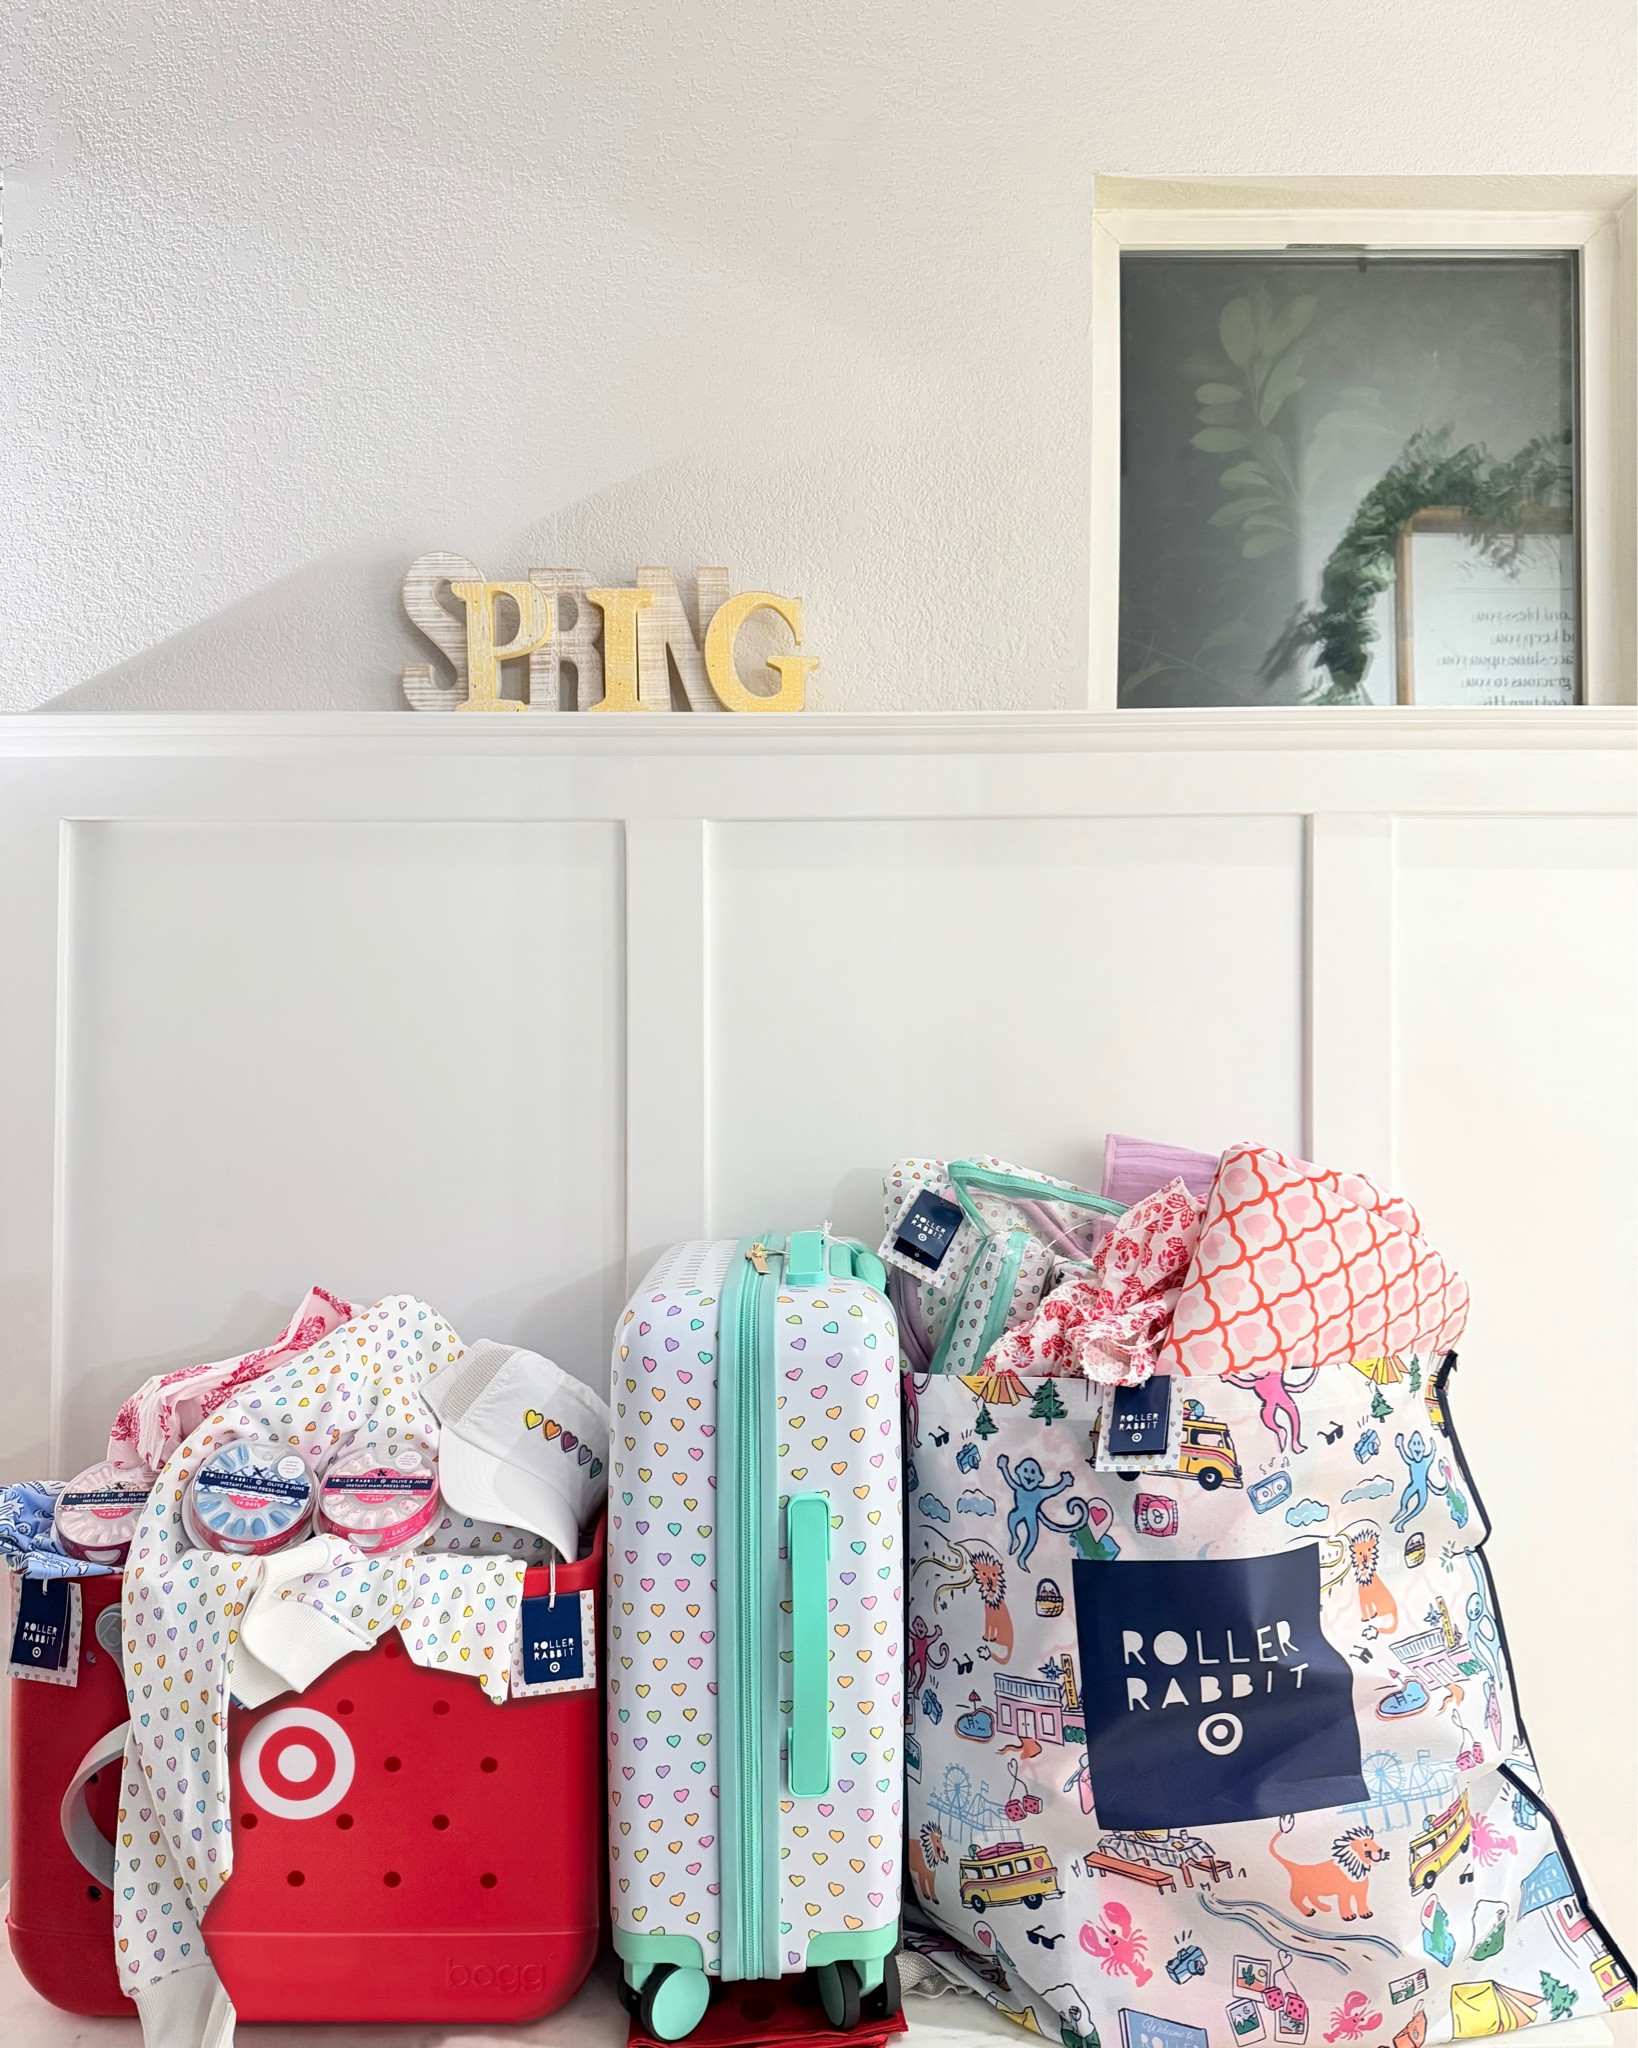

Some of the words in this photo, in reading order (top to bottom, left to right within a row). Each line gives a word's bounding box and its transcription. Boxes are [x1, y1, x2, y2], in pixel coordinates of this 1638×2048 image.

[402, 550, 820, 712] SPRING
[911, 1220, 943, 1239] RABBIT
[915, 1214, 946, 1234] ROLLER
[1119, 1413, 1159, 1422] ROLLER
[1119, 1422, 1158, 1431] RABBIT
[205, 1472, 229, 1480] ROLLER
[230, 1475, 253, 1484] RABBIT
[219, 1480, 243, 1488] INSTANT
[258, 1486, 288, 1495] PRESS-ONS
[391, 1525, 409, 1536] EASY
[24, 1622, 57, 1635] ROLLER
[22, 1632, 56, 1645] RABBIT
[533, 1638, 574, 1651] ROLLER
[1121, 1620, 1300, 1666] ROLLER
[533, 1647, 574, 1660] RABBIT
[1062, 1658, 1076, 1706] MOTEL
[1125, 1663, 1309, 1712] RABBIT
[446, 1956, 546, 1996] bogg
